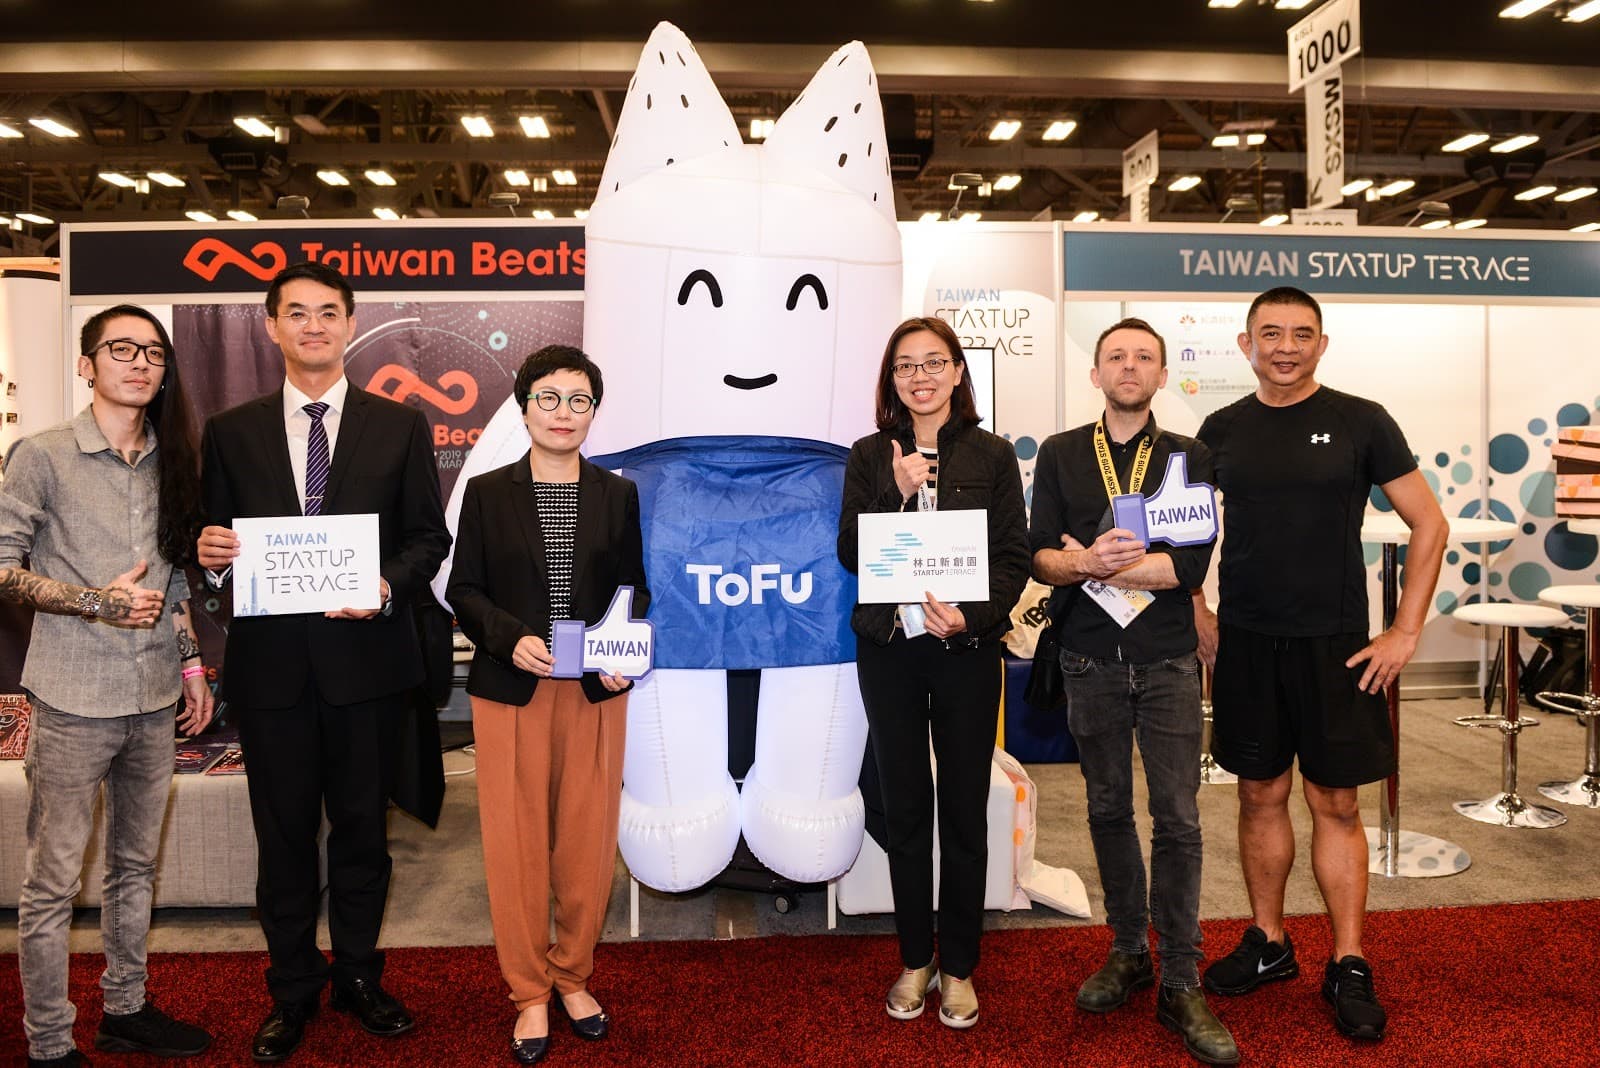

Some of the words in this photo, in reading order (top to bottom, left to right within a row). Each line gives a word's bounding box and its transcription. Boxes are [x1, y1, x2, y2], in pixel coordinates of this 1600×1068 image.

[1298, 20, 1351, 79] 1000
[1324, 77, 1342, 175] SXSW
[301, 242, 455, 277] Taiwan
[472, 241, 586, 276] Beats
[1179, 249, 1299, 277] TAIWAN
[1308, 251, 1417, 280] STARTUP
[1423, 254, 1530, 281] TERRACE
[936, 287, 1000, 302] TAIWAN
[934, 308, 1030, 329] STARTUP
[440, 449, 462, 460] 2019
[1096, 438, 1107, 458] STAFF
[439, 460, 463, 469] MAR
[1101, 458, 1112, 476] 2019
[1136, 459, 1145, 476] 2019
[1106, 475, 1118, 496] SXSW
[1148, 503, 1212, 526] TAIWAN
[265, 532, 327, 546] TAIWAN
[265, 549, 355, 571] STARTUP
[266, 572, 359, 594] TERRACE
[913, 569, 944, 577] STARTUP
[686, 563, 813, 606] ToFu
[587, 639, 648, 657] TAIWAN
